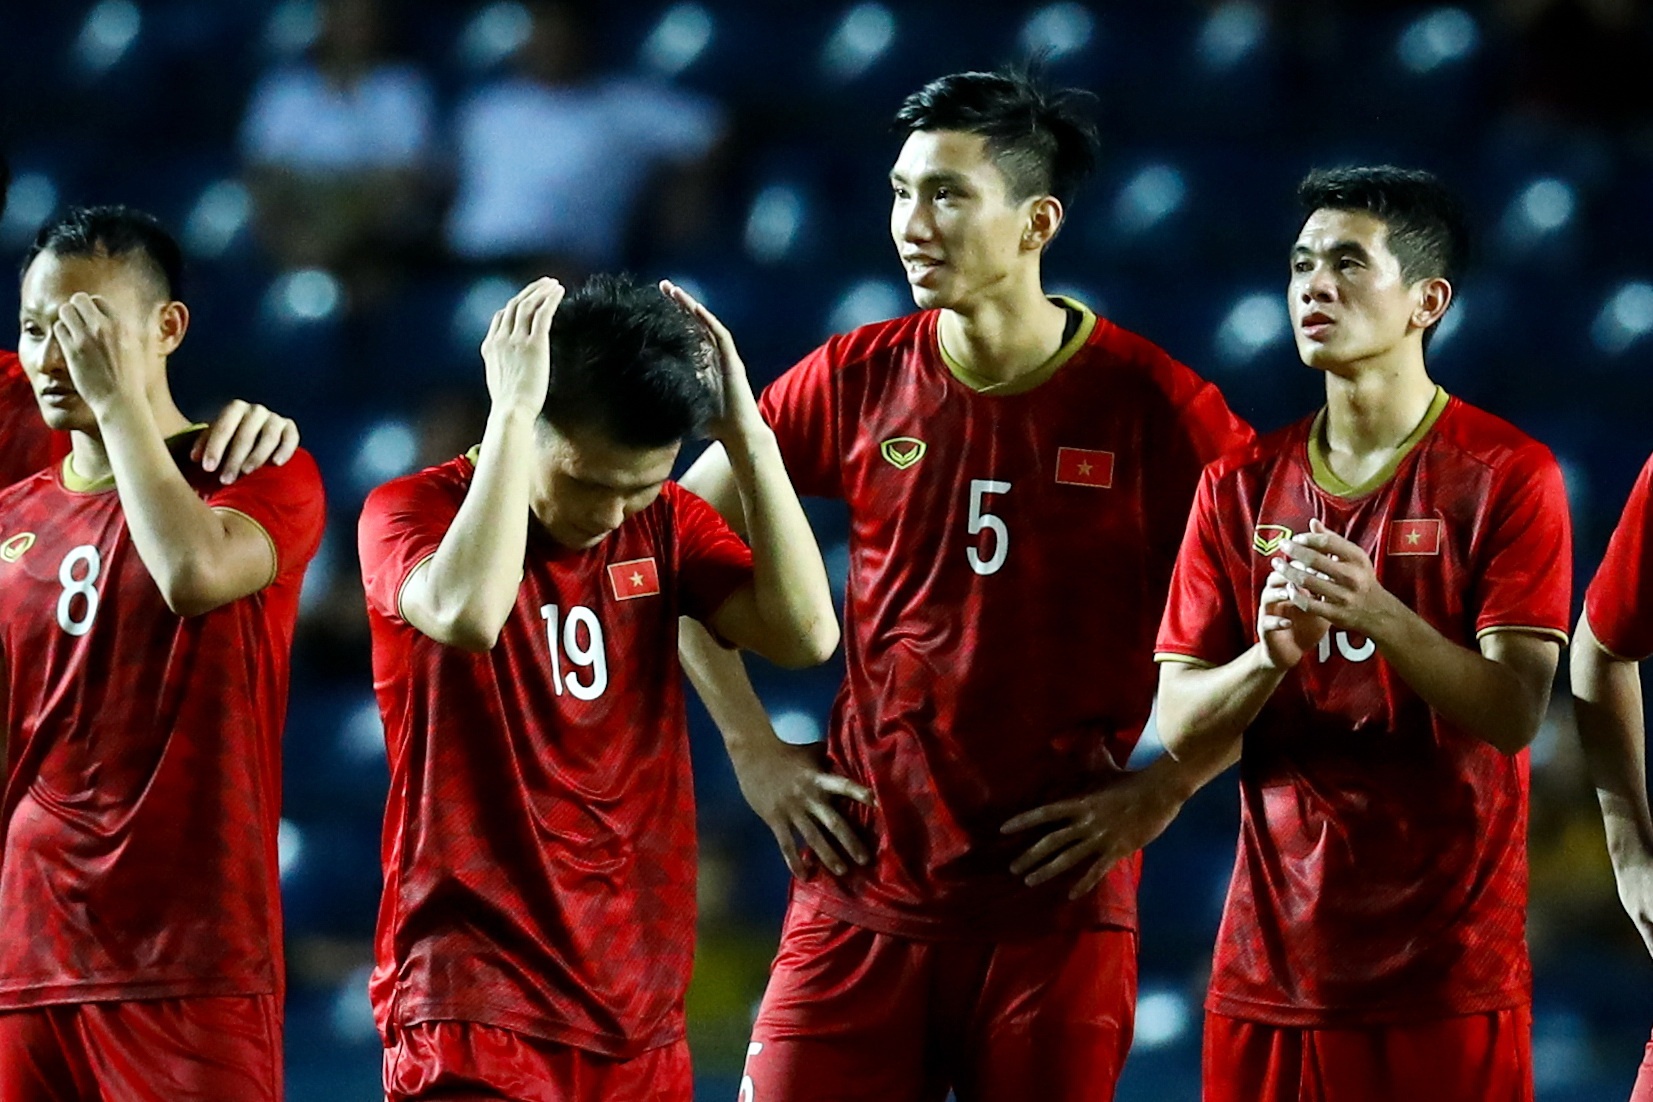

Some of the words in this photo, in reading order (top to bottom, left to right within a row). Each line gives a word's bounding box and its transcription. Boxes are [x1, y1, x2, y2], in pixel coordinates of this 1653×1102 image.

[966, 479, 1012, 576] 5
[56, 544, 101, 637] 8
[540, 603, 608, 701] 19
